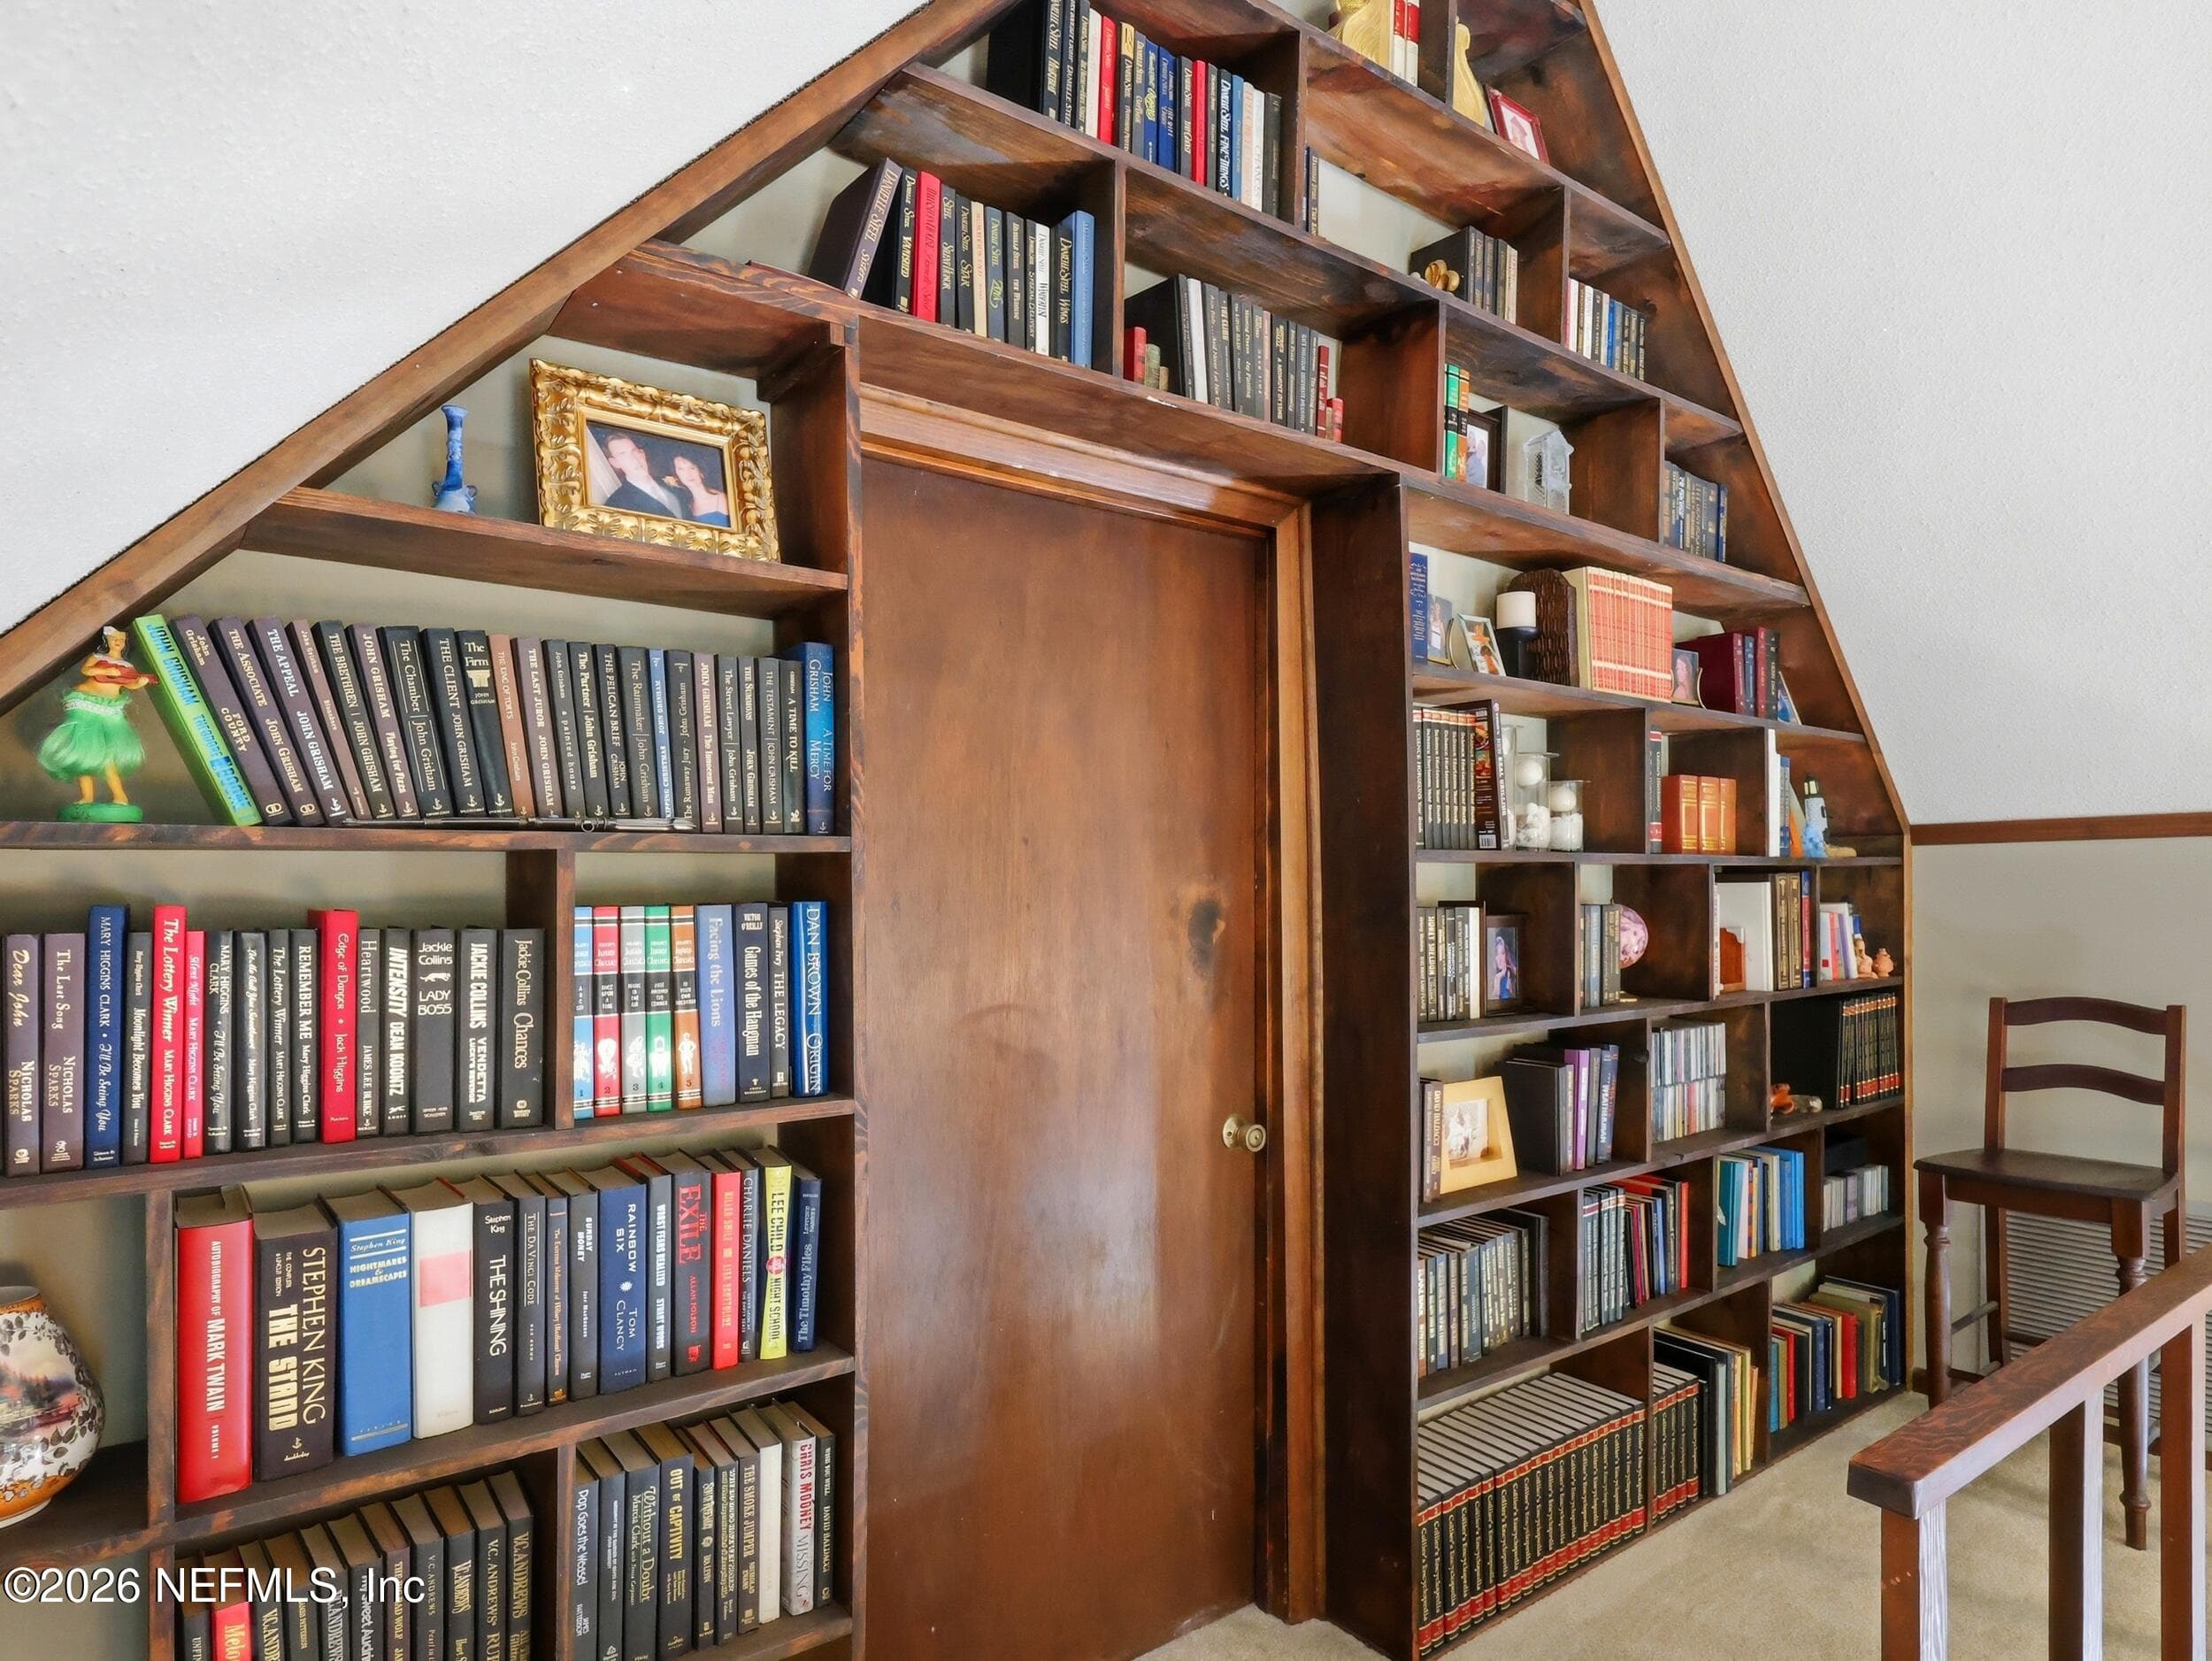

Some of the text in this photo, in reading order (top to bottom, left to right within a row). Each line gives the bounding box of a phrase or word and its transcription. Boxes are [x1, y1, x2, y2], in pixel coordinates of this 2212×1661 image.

[1220, 135, 1230, 156] FINE
[1220, 158, 1231, 189] THINGS
[228, 628, 243, 650] THE
[465, 642, 488, 666] The Firm
[329, 633, 358, 709] THE BRETHREN
[399, 640, 420, 712] The Chamber
[439, 638, 461, 709] THE CLIENT
[810, 658, 822, 712] GRISHAM
[822, 672, 833, 703] JOHN
[266, 628, 334, 790] THE APPEAL JOHN GRISHAM
[603, 652, 621, 747] THE PELICAN BRIEF
[631, 660, 643, 733] The Rainmaker
[221, 707, 251, 753] FORD COUNTY
[823, 740, 833, 767] TIME
[810, 740, 822, 780] MERCY
[823, 769, 833, 793] FOR
[419, 942, 453, 953] Jackie
[419, 955, 453, 965] Collins
[470, 942, 488, 980] JACKIE
[707, 917, 724, 961] Facing
[744, 945, 761, 980] Games
[51, 949, 72, 1030] The Last Song
[99, 915, 111, 1027] MARY HIGGINS CLARK
[159, 919, 180, 1042] The Lottery Winner
[337, 961, 348, 973] of
[360, 940, 377, 1013] Heartwood
[710, 965, 720, 984] the
[745, 980, 759, 994] of
[9, 992, 30, 1027] John
[298, 945, 312, 1040] REMEMBER ME
[334, 974, 349, 1010] Danger
[418, 1004, 452, 1016] BOSS
[419, 989, 451, 1001] LADY
[469, 981, 488, 1030] COLLINS
[513, 939, 534, 1070] Jackie Collins Chances
[710, 988, 724, 1028] Lions
[745, 995, 759, 1011] the
[773, 972, 786, 1050] THE LEGACY
[806, 908, 823, 1095] DAN BROWN ORIGIN
[336, 1033, 348, 1053] Jack
[388, 946, 408, 1096] INTENSITY DEAN KOONTZ
[9, 1059, 35, 1123] NICHOLAS SPARKS
[476, 1036, 487, 1103] VENDETTA
[350, 1237, 405, 1252] Stephen King
[679, 1183, 708, 1265] THE EXILE
[742, 1177, 753, 1284] CHARLIE DANIELS
[770, 1192, 785, 1303] LEE CHILD NIGHT
[527, 1213, 536, 1306] THE DA VINCI CODE
[616, 1203, 638, 1352] RAINBOW SIX TOM CLANCY
[489, 1255, 507, 1357] THE SHINING
[798, 1244, 813, 1342] The Timothy Files
[207, 1318, 226, 1363] MARK
[303, 1246, 326, 1426] STEPHEN KING
[206, 1364, 226, 1413] TWAIN
[268, 1303, 298, 1432] THE STAND
[670, 1467, 683, 1490] OUT
[743, 1465, 756, 1483] THE
[576, 1489, 588, 1511] Pop
[642, 1485, 657, 1542] Without
[796, 1444, 813, 1598] CHRIS MOONEY MISSING
[577, 1539, 588, 1552] the
[669, 1504, 683, 1561] CAPTIVITY
[576, 1552, 588, 1588] Weasel
[641, 1557, 655, 1603] Doubt
